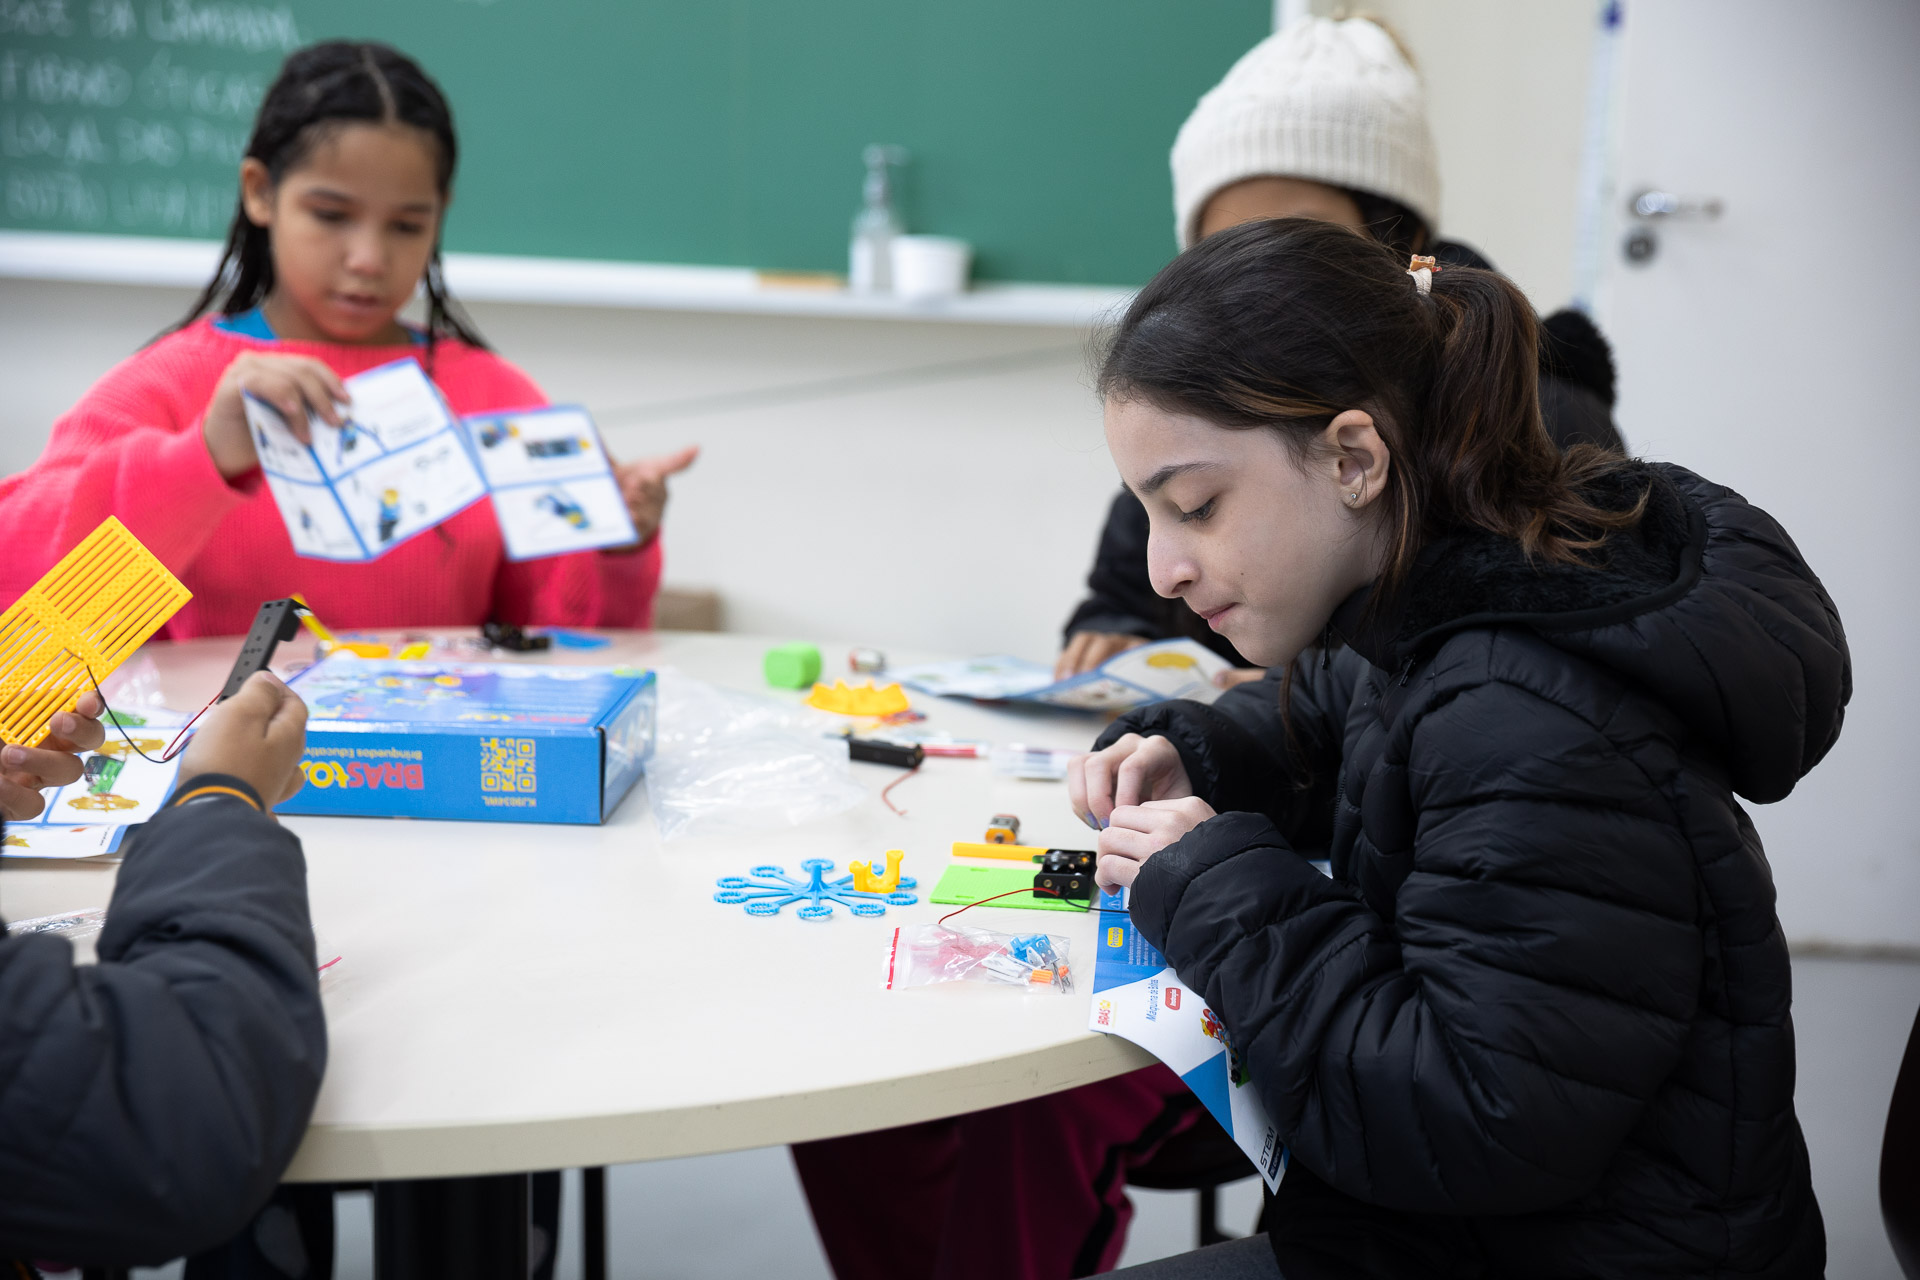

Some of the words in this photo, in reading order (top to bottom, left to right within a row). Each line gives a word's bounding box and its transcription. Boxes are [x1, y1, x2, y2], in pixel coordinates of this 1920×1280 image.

[304, 747, 355, 759] Educativ
[356, 747, 423, 760] Brinquedos
[1260, 1126, 1275, 1169] STEM
